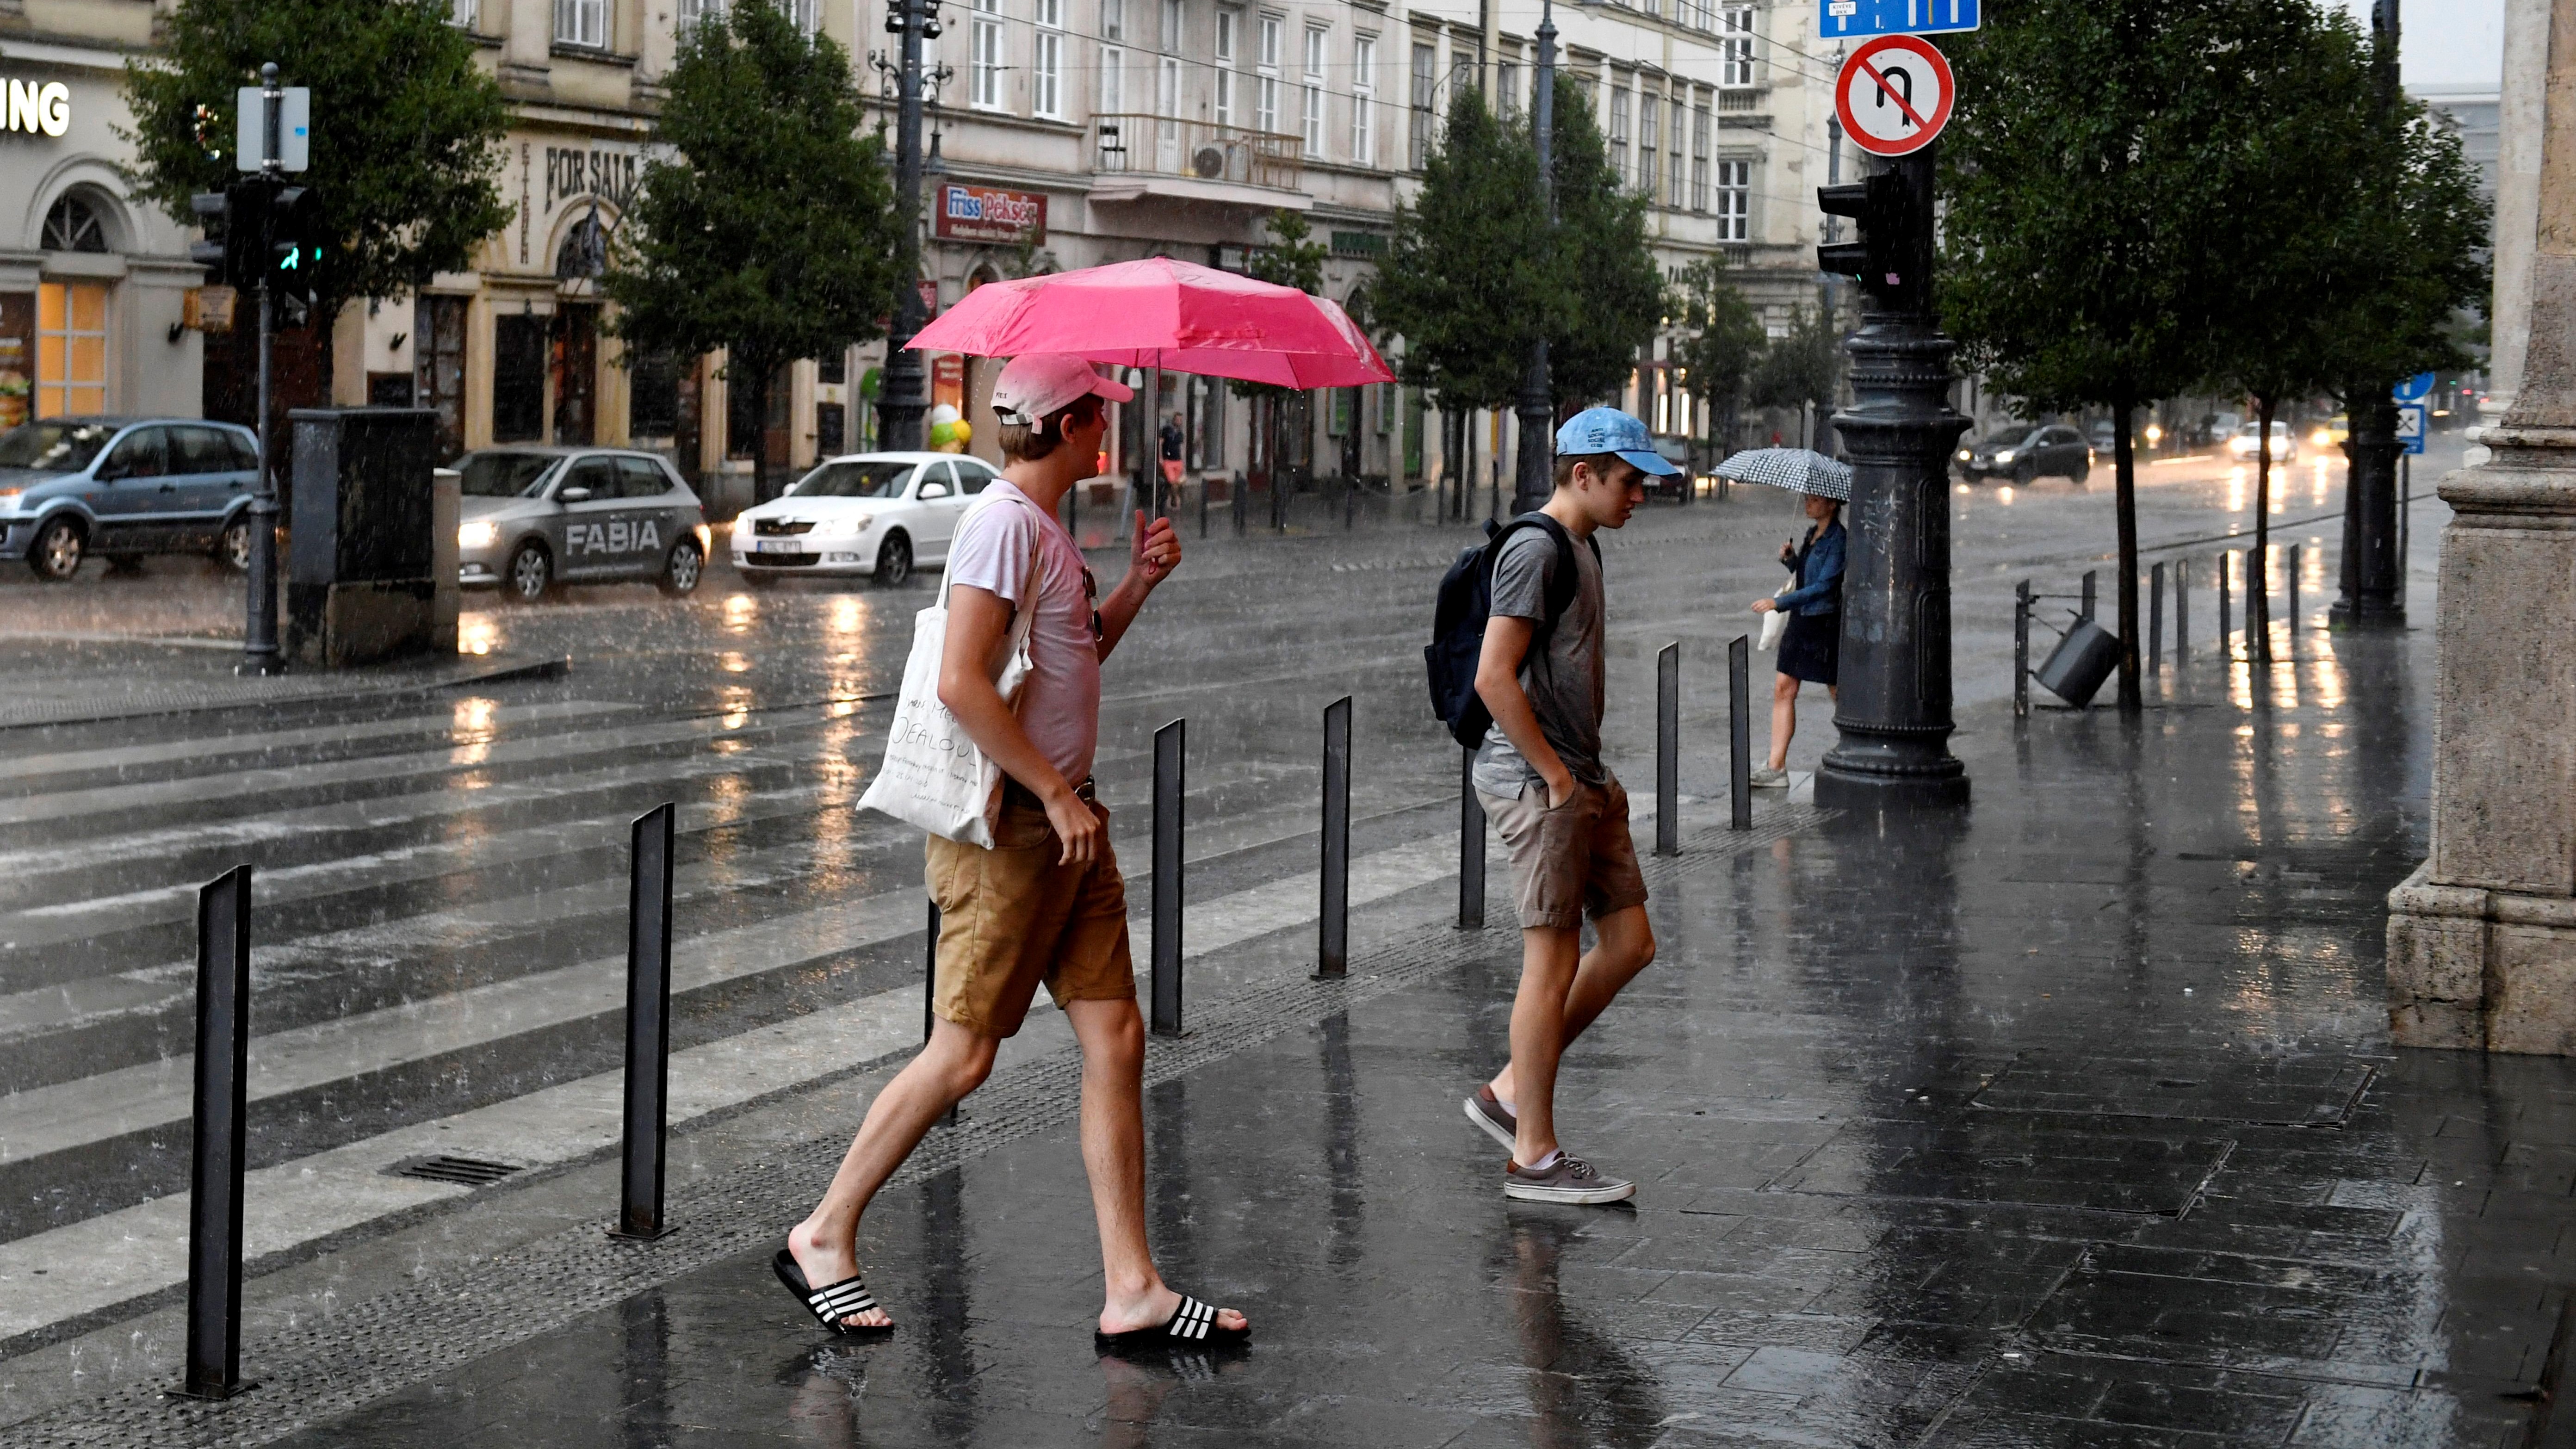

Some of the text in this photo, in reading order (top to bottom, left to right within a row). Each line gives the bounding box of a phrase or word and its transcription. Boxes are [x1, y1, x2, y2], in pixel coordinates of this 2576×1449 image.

[545, 146, 585, 215] FOR
[948, 186, 981, 220] Friss
[566, 520, 660, 556] FABIA
